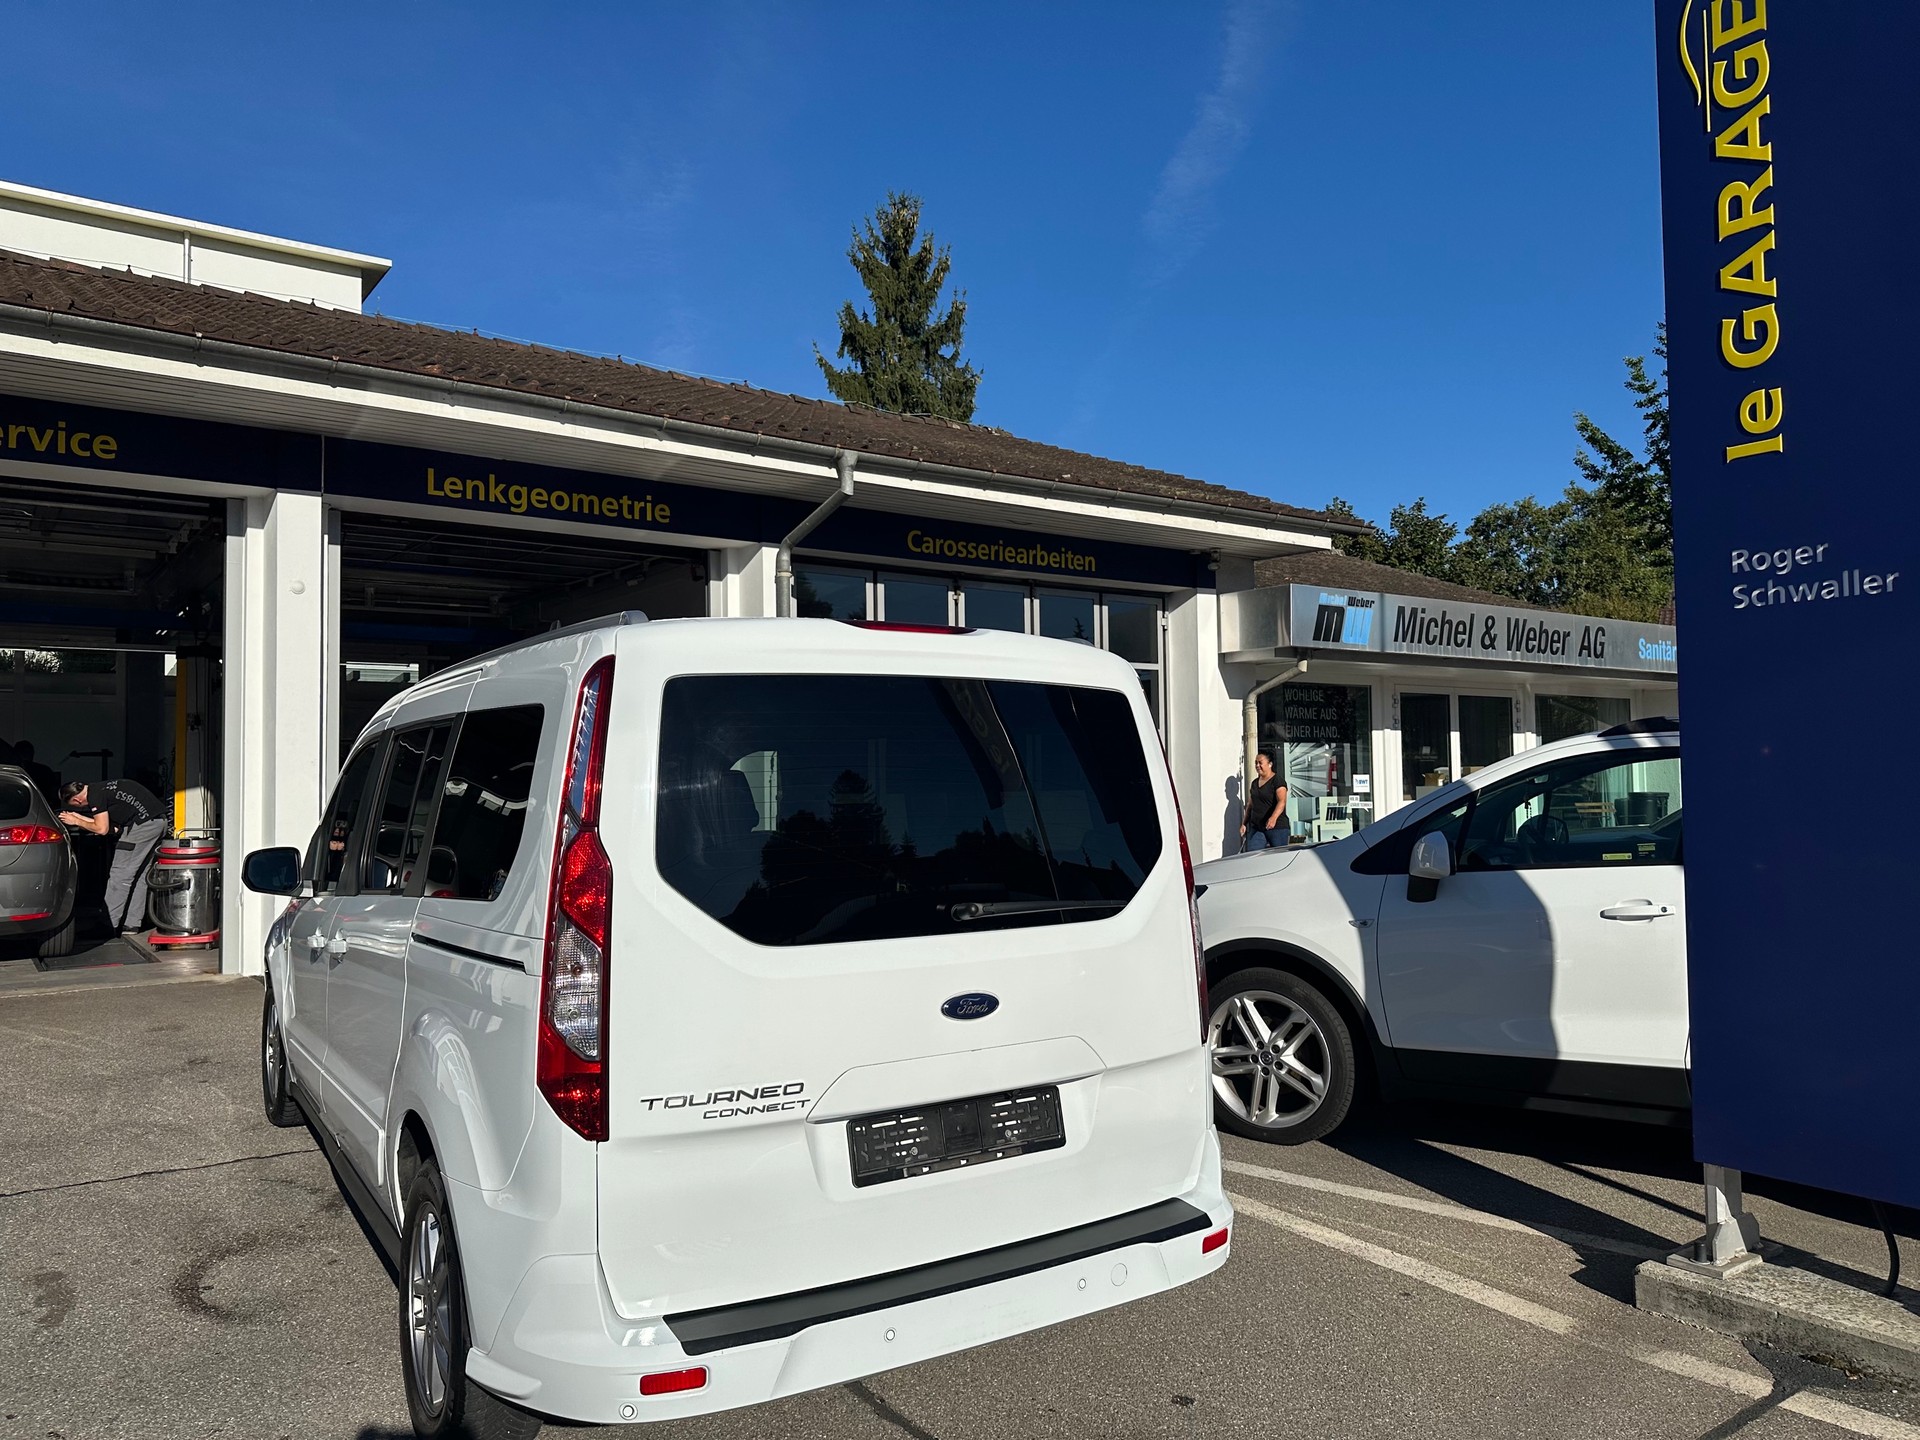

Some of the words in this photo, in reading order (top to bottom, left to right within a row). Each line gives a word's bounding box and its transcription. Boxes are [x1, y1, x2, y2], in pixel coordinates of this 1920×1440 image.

[1712, 0, 1780, 369] GARAGE
[0, 420, 118, 459] rvice
[1726, 387, 1783, 463] le
[427, 468, 671, 523] Lenkgeometrie
[907, 530, 1096, 572] Carosseriearbeiten
[1731, 542, 1829, 575] Roger
[1347, 596, 1375, 608] Weber
[1732, 569, 1900, 609] Schwaller
[1393, 605, 1475, 648] Michel
[1480, 615, 1498, 650] &
[1506, 617, 1571, 655] Weber
[1578, 625, 1606, 659] AG
[1638, 638, 1677, 662] Sanitär
[1284, 688, 1324, 702] WOHLIGE
[1285, 705, 1318, 720] WÄRME
[1319, 706, 1337, 720] AUS
[1286, 725, 1311, 738] EINER
[1313, 725, 1340, 738] HAND.
[957, 998, 989, 1015] Ford
[640, 1081, 805, 1111] TOURNEO
[703, 1099, 810, 1120] CONNECT
